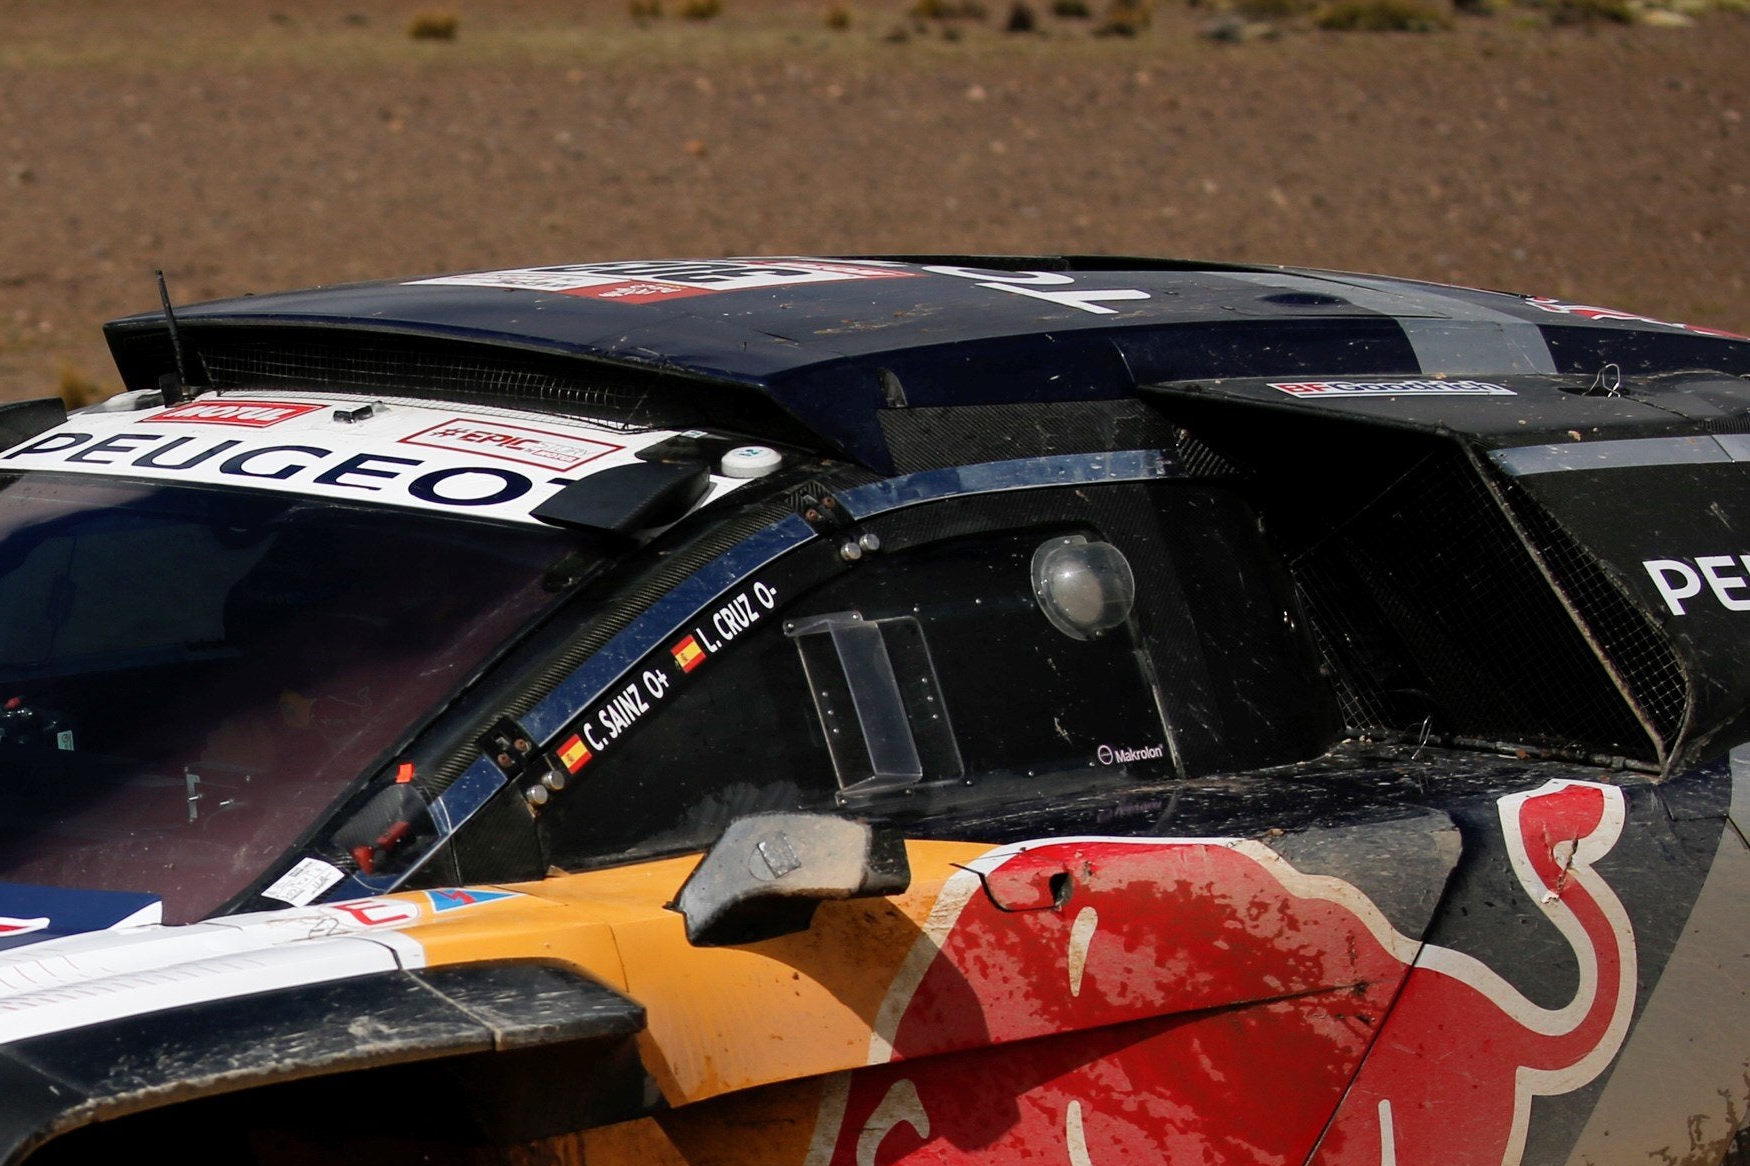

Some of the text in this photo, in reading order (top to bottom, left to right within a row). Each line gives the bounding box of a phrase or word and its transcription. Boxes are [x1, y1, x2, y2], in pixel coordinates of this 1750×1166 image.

[1276, 380, 1503, 394] BFGoodrich
[163, 405, 297, 421] MOTUL
[696, 627, 722, 653] L.
[712, 593, 760, 641] CRUZ
[583, 722, 609, 752] C.
[598, 683, 650, 739] SAINZ
